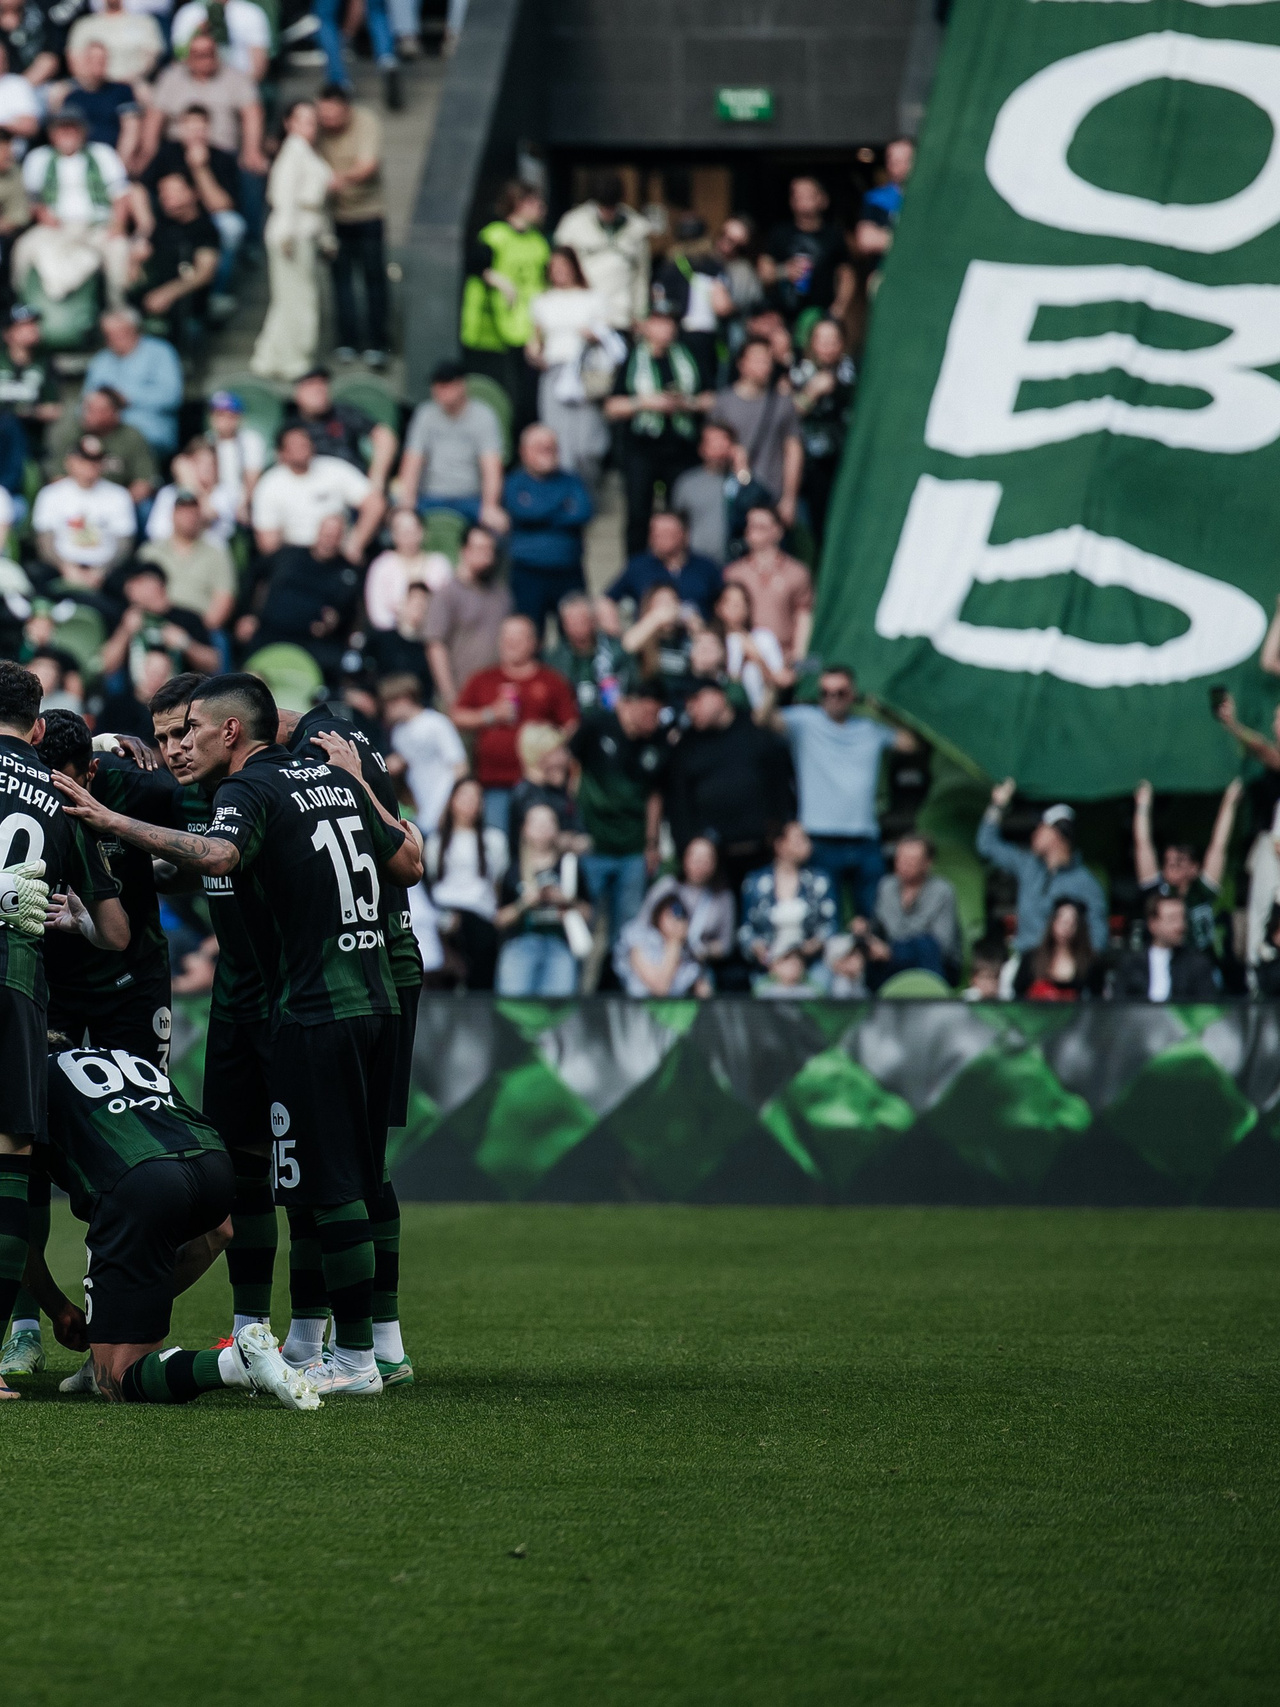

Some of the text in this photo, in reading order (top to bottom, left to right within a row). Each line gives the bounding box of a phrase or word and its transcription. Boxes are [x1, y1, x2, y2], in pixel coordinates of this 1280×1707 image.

[876, 0, 1280, 687] ОВЬ
[187, 823, 208, 832] OZON
[311, 816, 381, 924] 15
[338, 929, 385, 952] OZON
[57, 1047, 171, 1099] 66
[273, 1140, 301, 1189] 15
